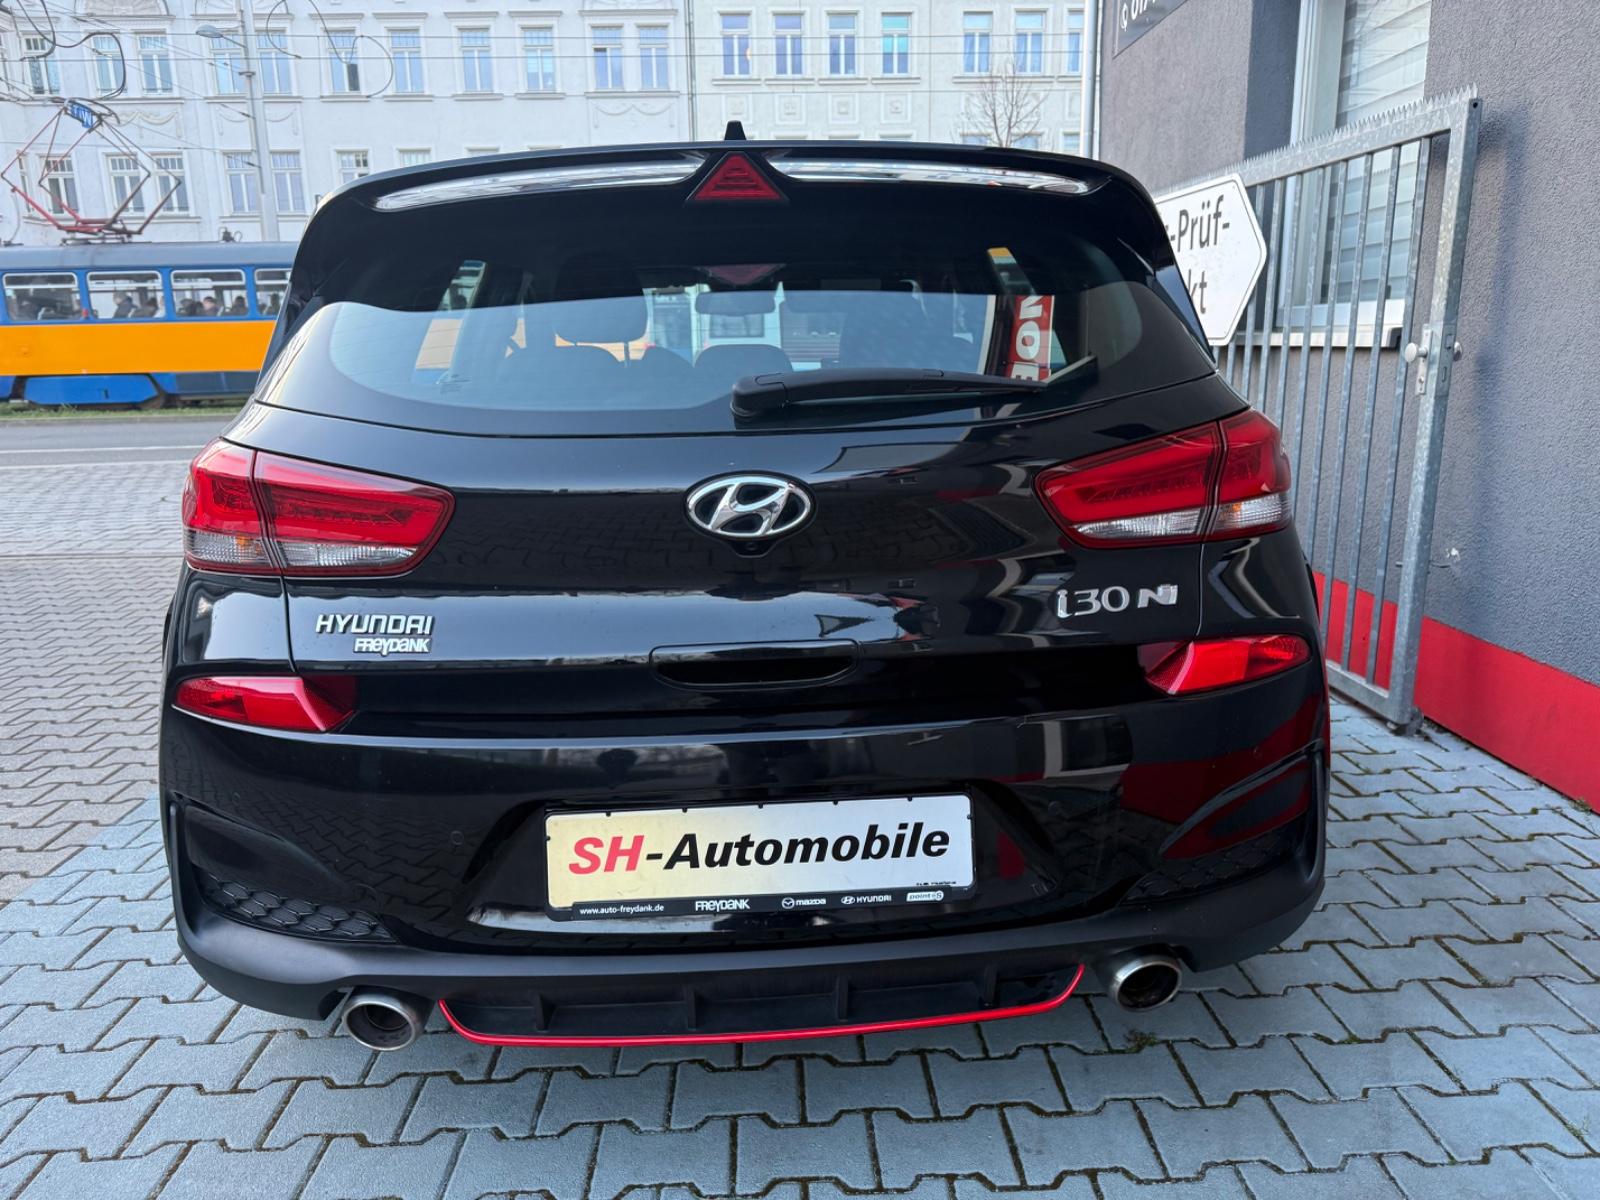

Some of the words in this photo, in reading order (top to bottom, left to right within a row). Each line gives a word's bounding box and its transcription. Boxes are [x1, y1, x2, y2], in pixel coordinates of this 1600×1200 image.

[1165, 194, 1230, 252] -Prüf-
[1057, 586, 1130, 618] i30
[1137, 584, 1178, 608] N
[315, 614, 433, 634] HYUNDAI
[568, 822, 950, 875] SH-Automobile
[579, 904, 665, 915] www.auto-freydank.de
[856, 895, 892, 904] HYUNDAI
